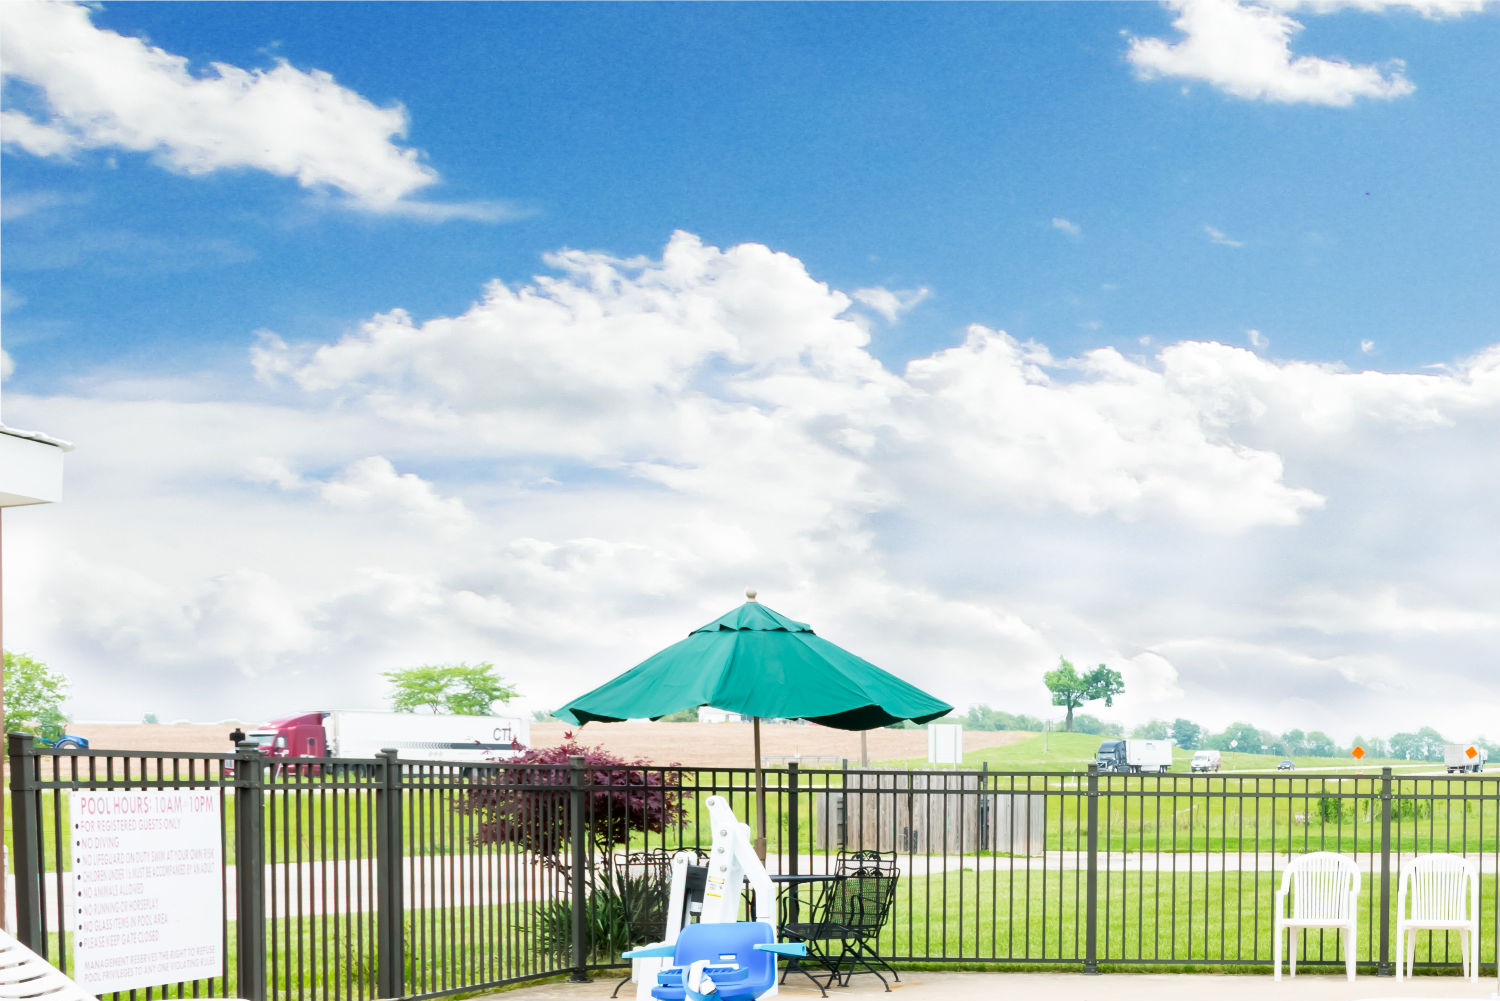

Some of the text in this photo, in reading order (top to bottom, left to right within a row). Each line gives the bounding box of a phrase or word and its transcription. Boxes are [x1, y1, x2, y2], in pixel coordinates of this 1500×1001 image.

[81, 797, 111, 816] POOL
[113, 796, 151, 815] HOURS:
[155, 795, 182, 814] 10AM
[190, 795, 214, 813] 10PM
[80, 818, 181, 833] FOR REGISTERED GUESTS ONLY
[81, 836, 120, 849] NO DIVING
